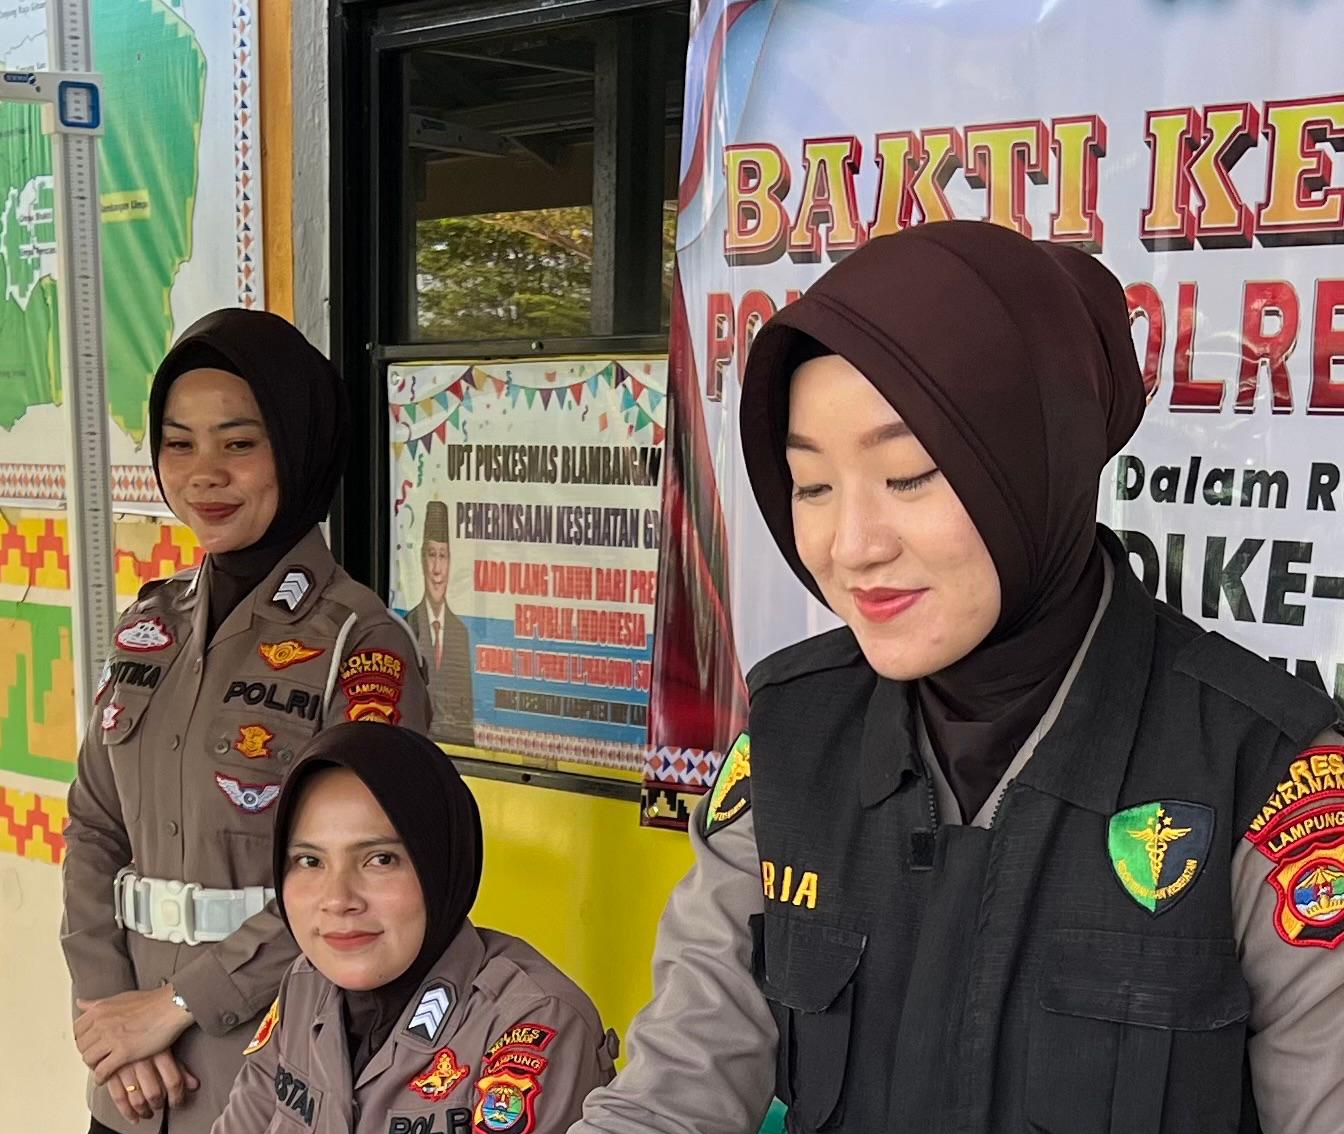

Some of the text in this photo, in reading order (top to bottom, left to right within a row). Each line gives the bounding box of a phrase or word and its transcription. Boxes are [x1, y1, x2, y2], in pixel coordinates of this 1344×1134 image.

[723, 114, 1107, 265] BAKTI
[447, 443, 662, 487] UPT PUSKESMAS BLAMBANGAN
[1115, 455, 1288, 509] Dalam
[456, 502, 552, 543] PEMERIKSAAN
[556, 505, 640, 548] KESEHATAN
[223, 681, 324, 722] POLRI
